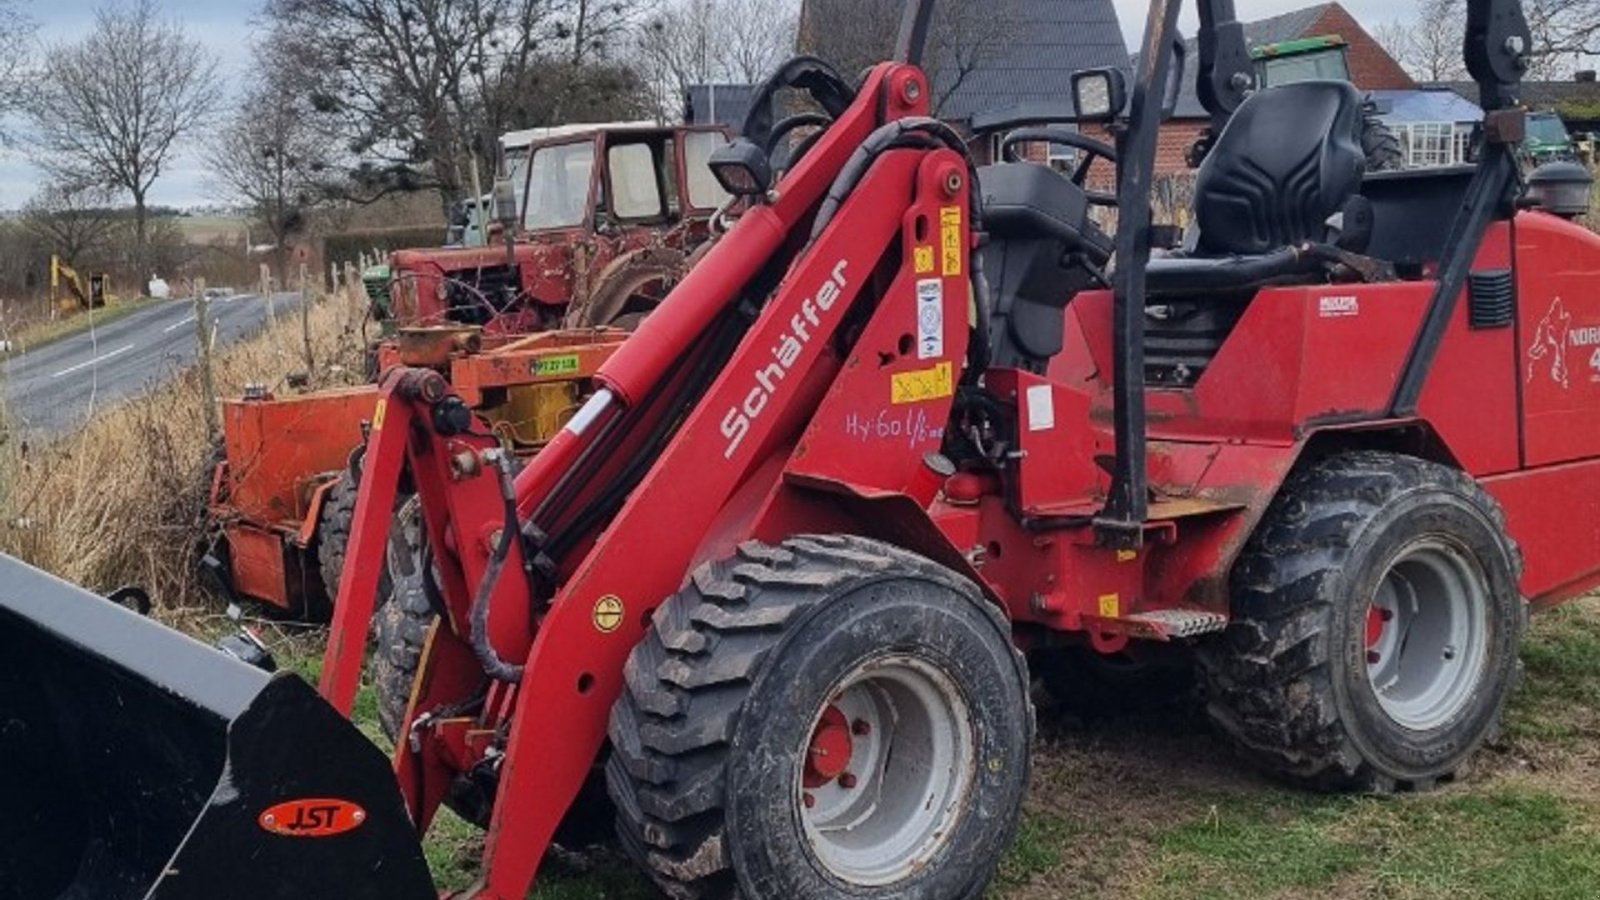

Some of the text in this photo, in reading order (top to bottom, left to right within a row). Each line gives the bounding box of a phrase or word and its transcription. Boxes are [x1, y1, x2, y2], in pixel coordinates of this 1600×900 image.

[1569, 325, 1600, 347] NOR
[719, 258, 848, 460] Schäffer
[286, 805, 341, 830] JST
